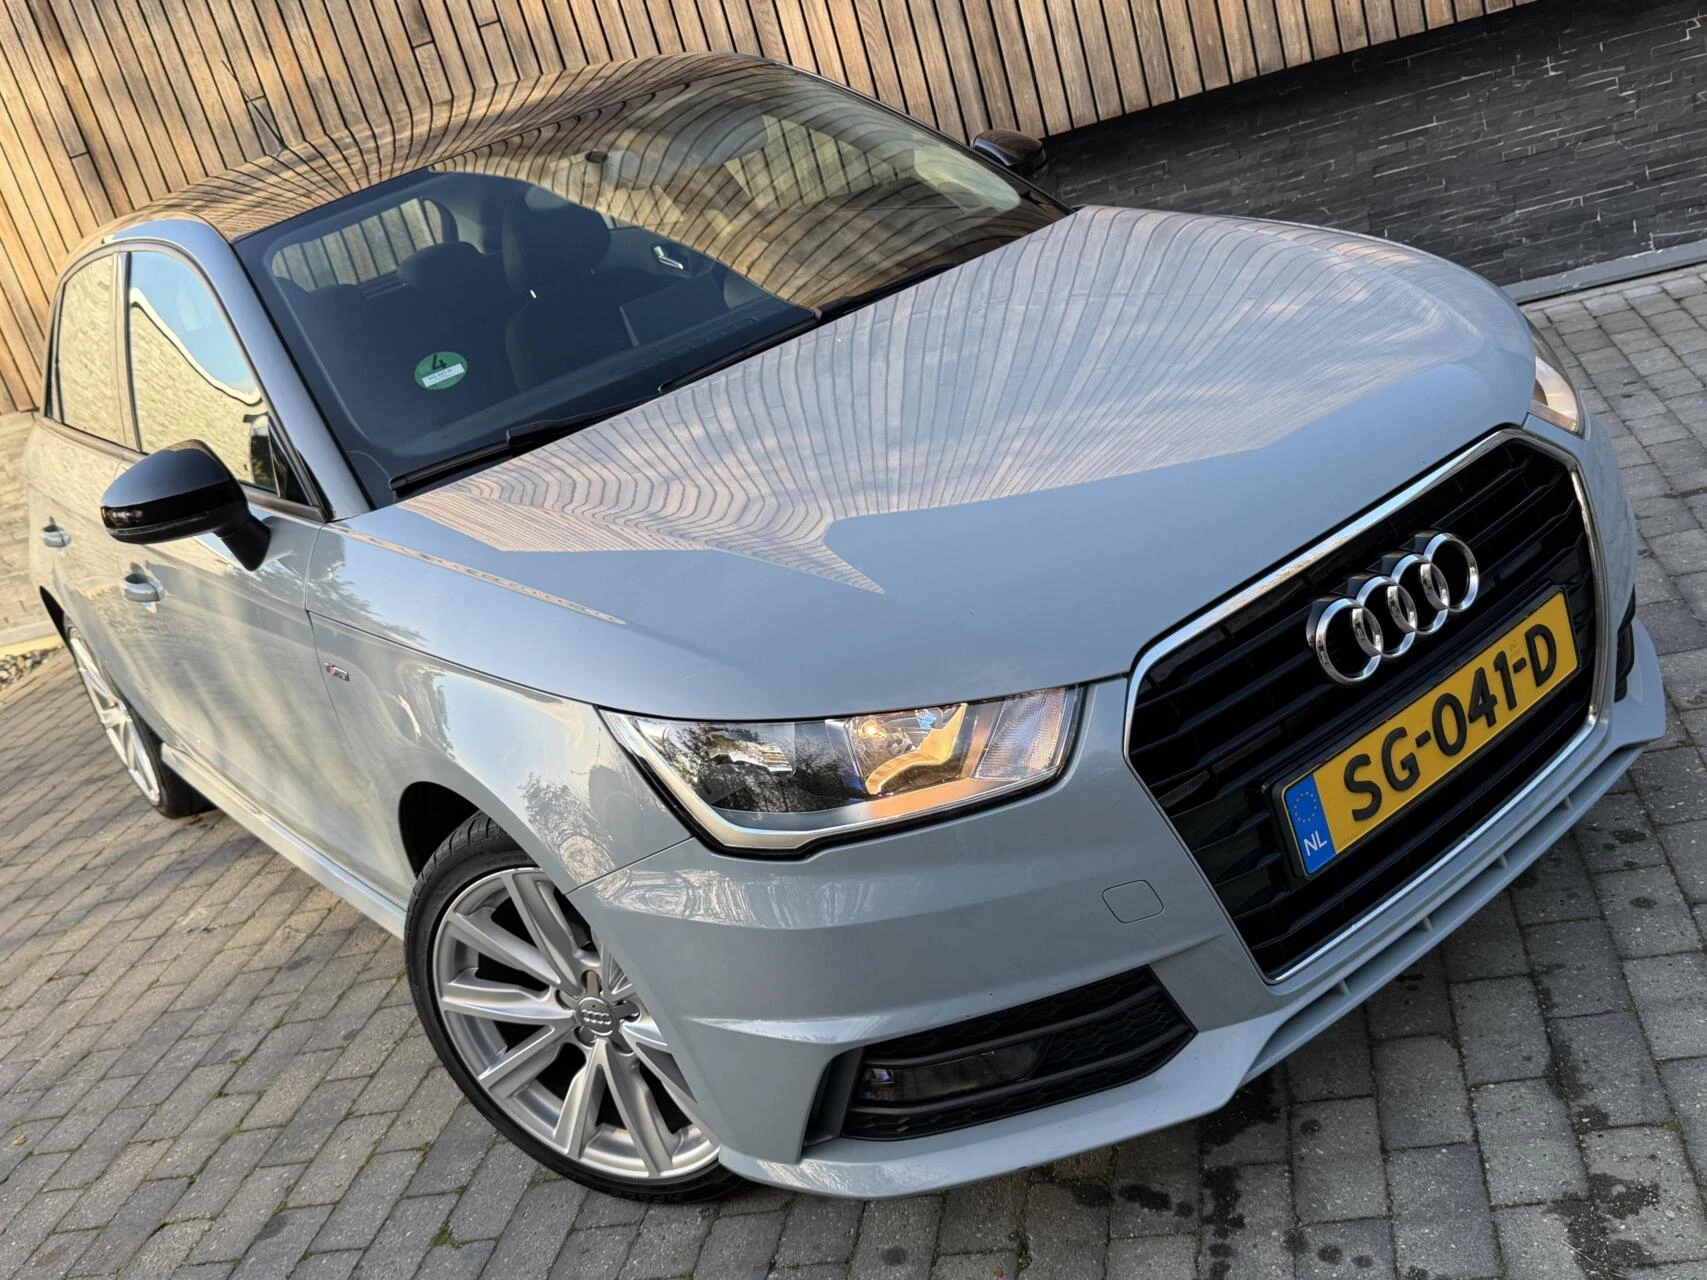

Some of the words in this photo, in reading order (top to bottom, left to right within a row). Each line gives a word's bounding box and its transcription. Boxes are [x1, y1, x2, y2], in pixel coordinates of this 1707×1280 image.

[432, 354, 448, 370] 4
[1344, 623, 1557, 821] SG-041-D
[1303, 830, 1328, 857] NL
